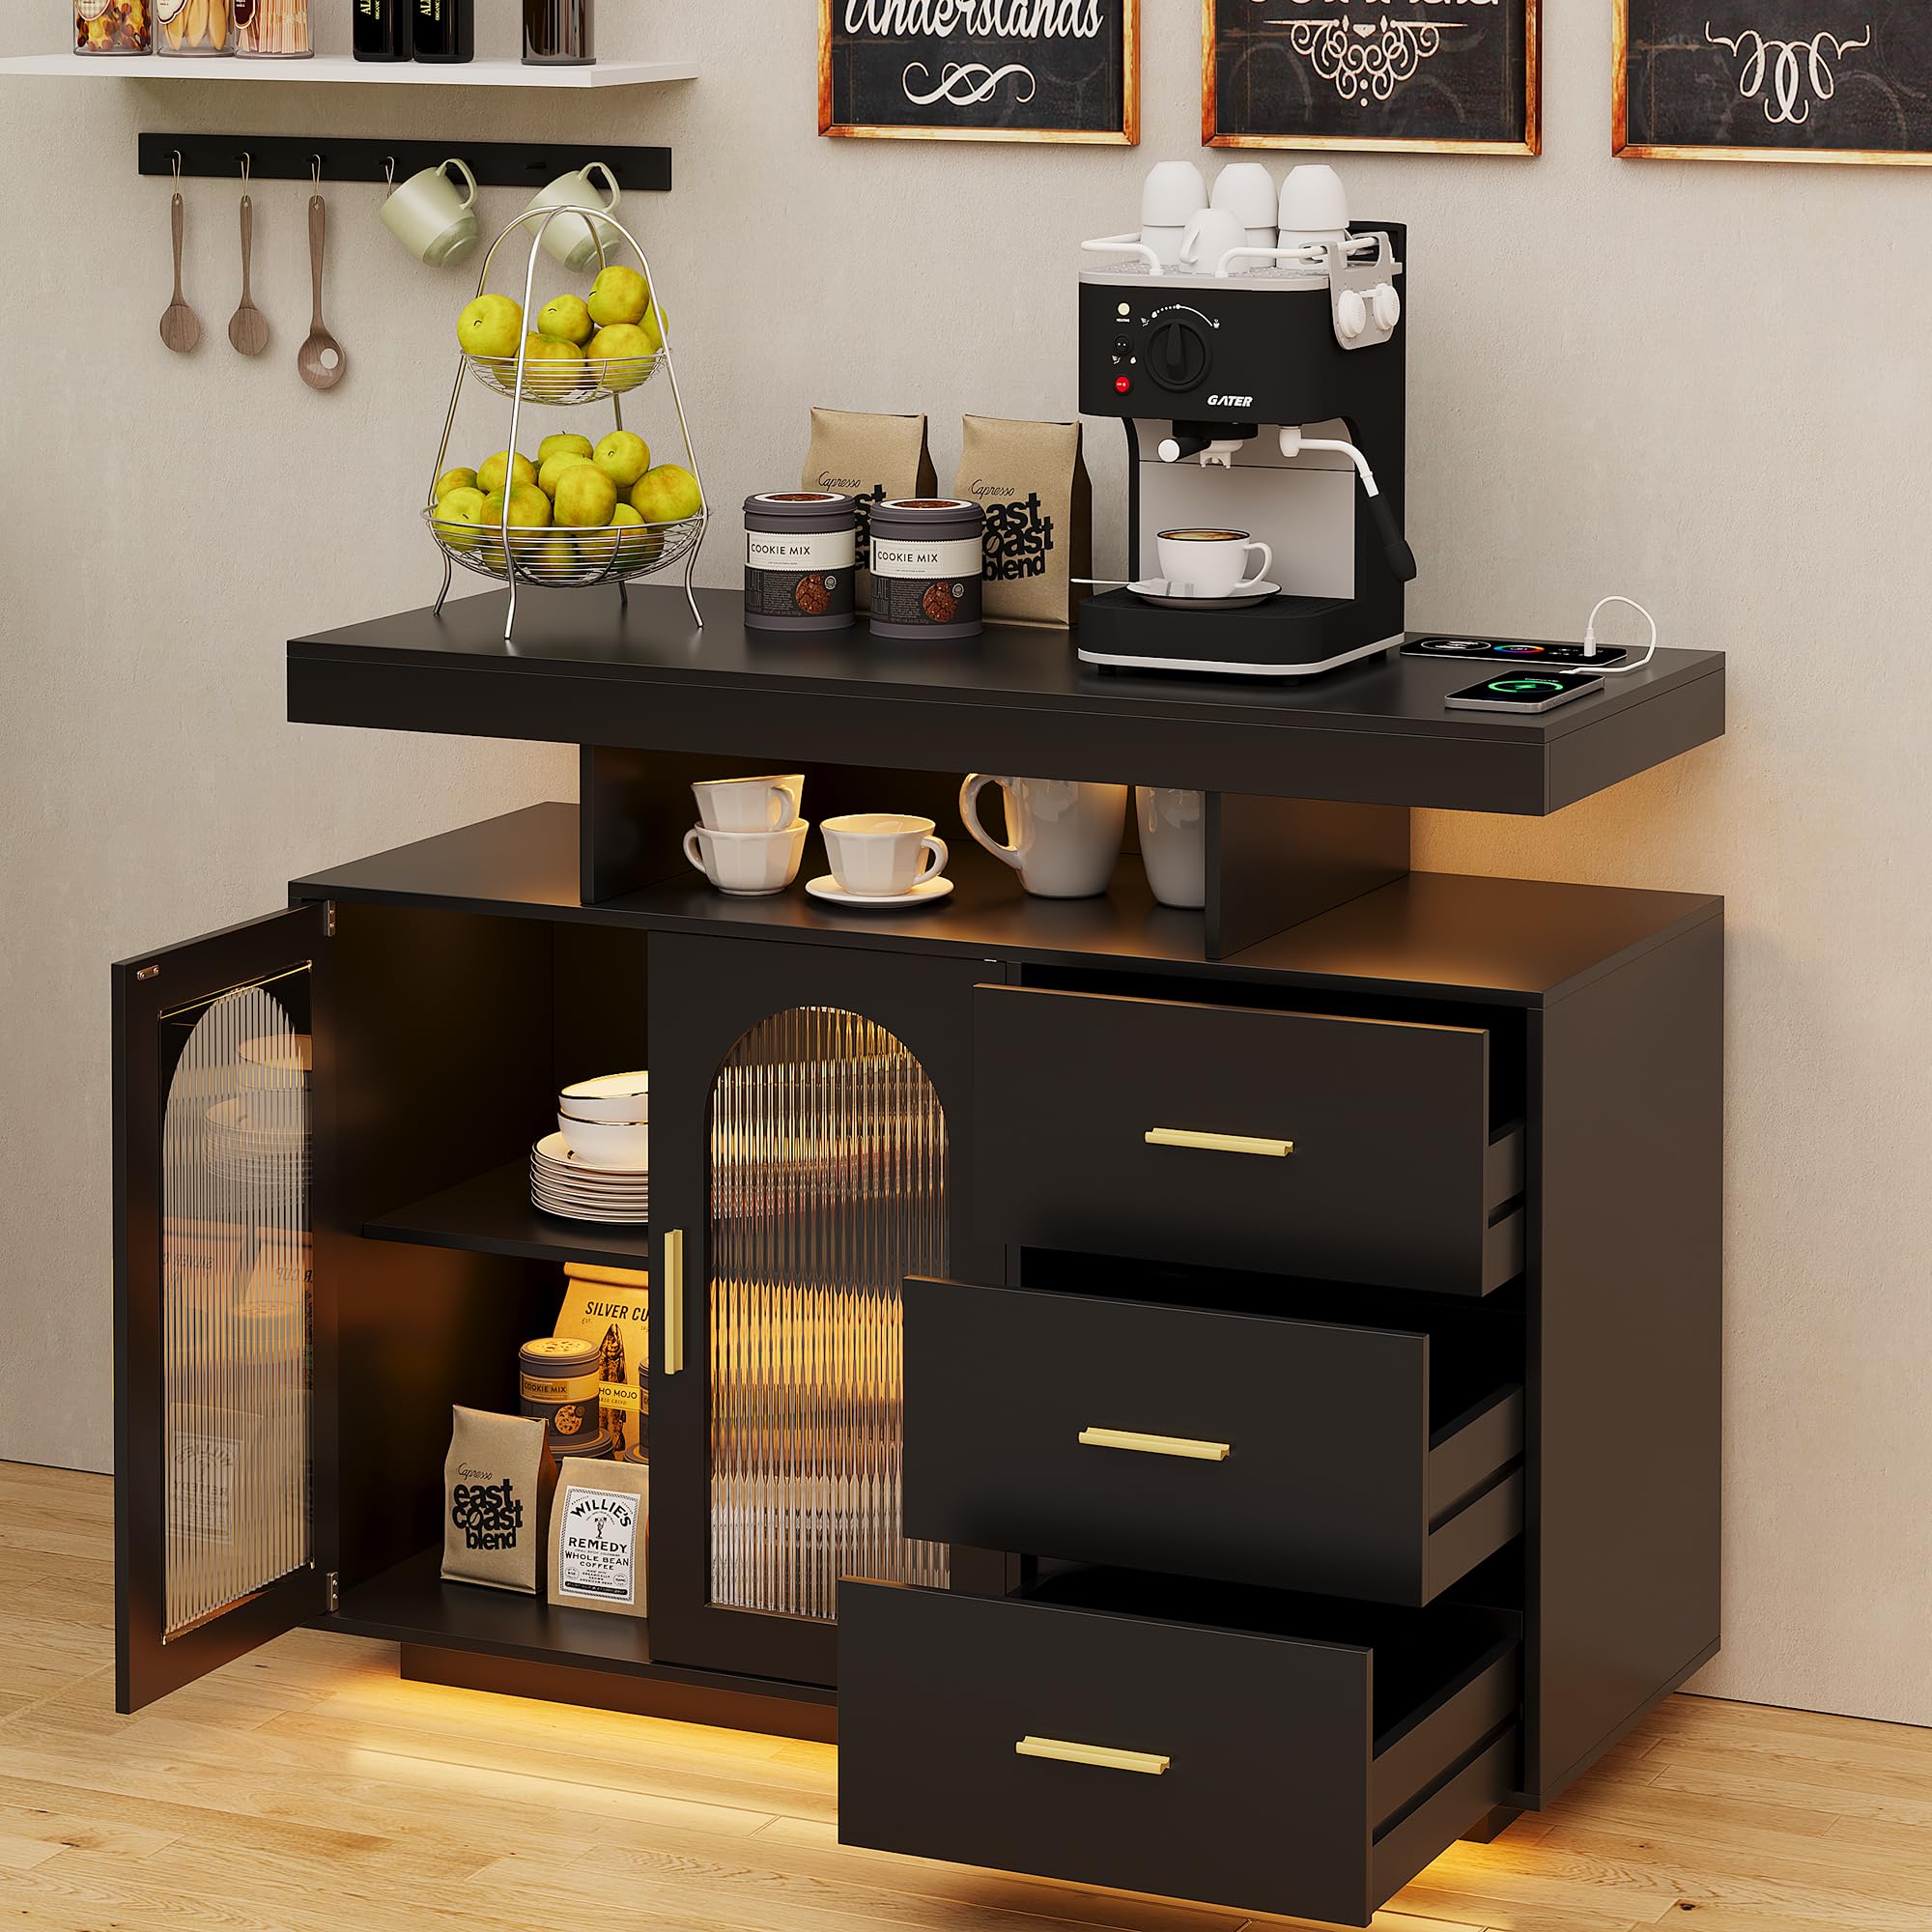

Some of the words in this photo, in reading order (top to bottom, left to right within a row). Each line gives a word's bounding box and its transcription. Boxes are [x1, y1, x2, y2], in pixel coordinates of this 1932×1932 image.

[1207, 394, 1253, 408] GATER
[817, 470, 862, 491] Capresso
[969, 479, 1015, 498] Capresso
[982, 493, 1041, 530] ast
[751, 543, 786, 555] COOKIE
[789, 546, 811, 555] MIX
[877, 551, 914, 563] COOKIE
[917, 554, 939, 563] MIX
[584, 1301, 629, 1320] SILVER
[632, 1307, 649, 1322] CU
[524, 1381, 549, 1393] COOKIE
[551, 1385, 567, 1394] MIX
[613, 1389, 638, 1400] MOJO
[455, 1463, 494, 1481] Capresso
[453, 1478, 513, 1509] east
[452, 1499, 524, 1531] coast
[570, 1498, 632, 1527] WILLIE'S
[465, 1525, 517, 1550] blend
[568, 1537, 628, 1553] REMEDY
[564, 1550, 600, 1562] WHOLE
[602, 1557, 630, 1567] BEAN
[580, 1561, 614, 1571] COFFEE
